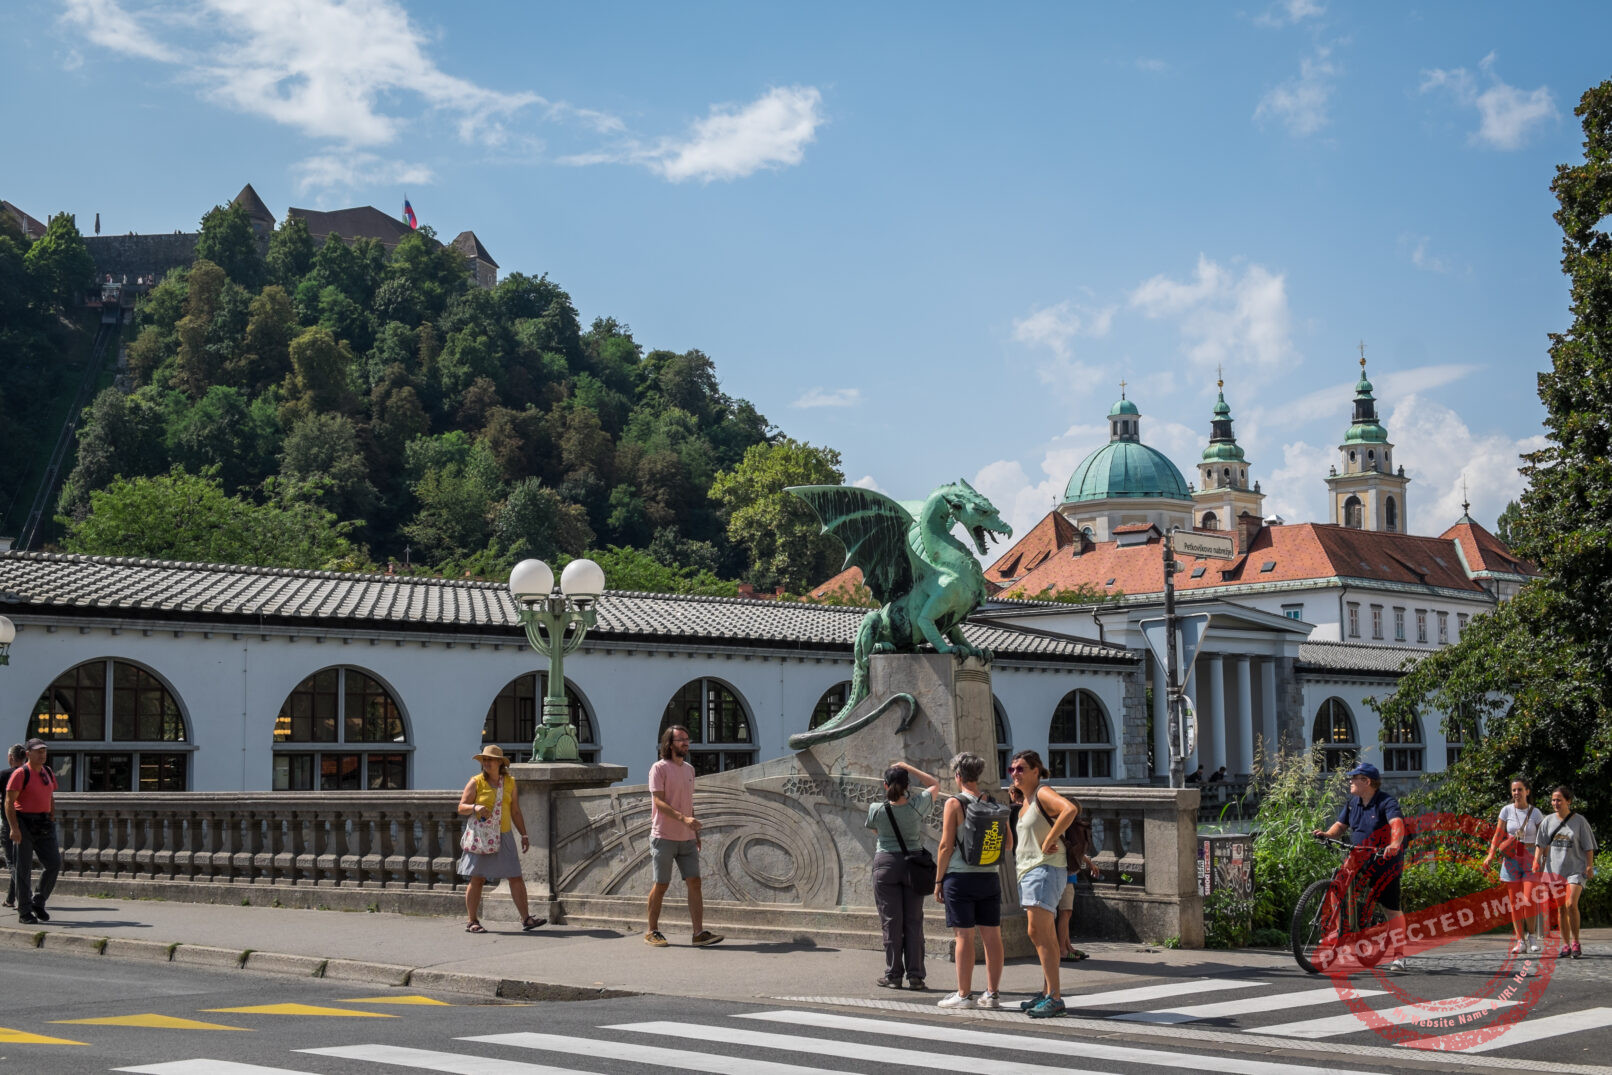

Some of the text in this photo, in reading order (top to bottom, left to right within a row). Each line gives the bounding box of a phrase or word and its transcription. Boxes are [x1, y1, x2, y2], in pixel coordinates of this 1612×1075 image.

[983, 830, 991, 850] FACE
[990, 821, 999, 850] NORTH
[995, 835, 1003, 850] THE
